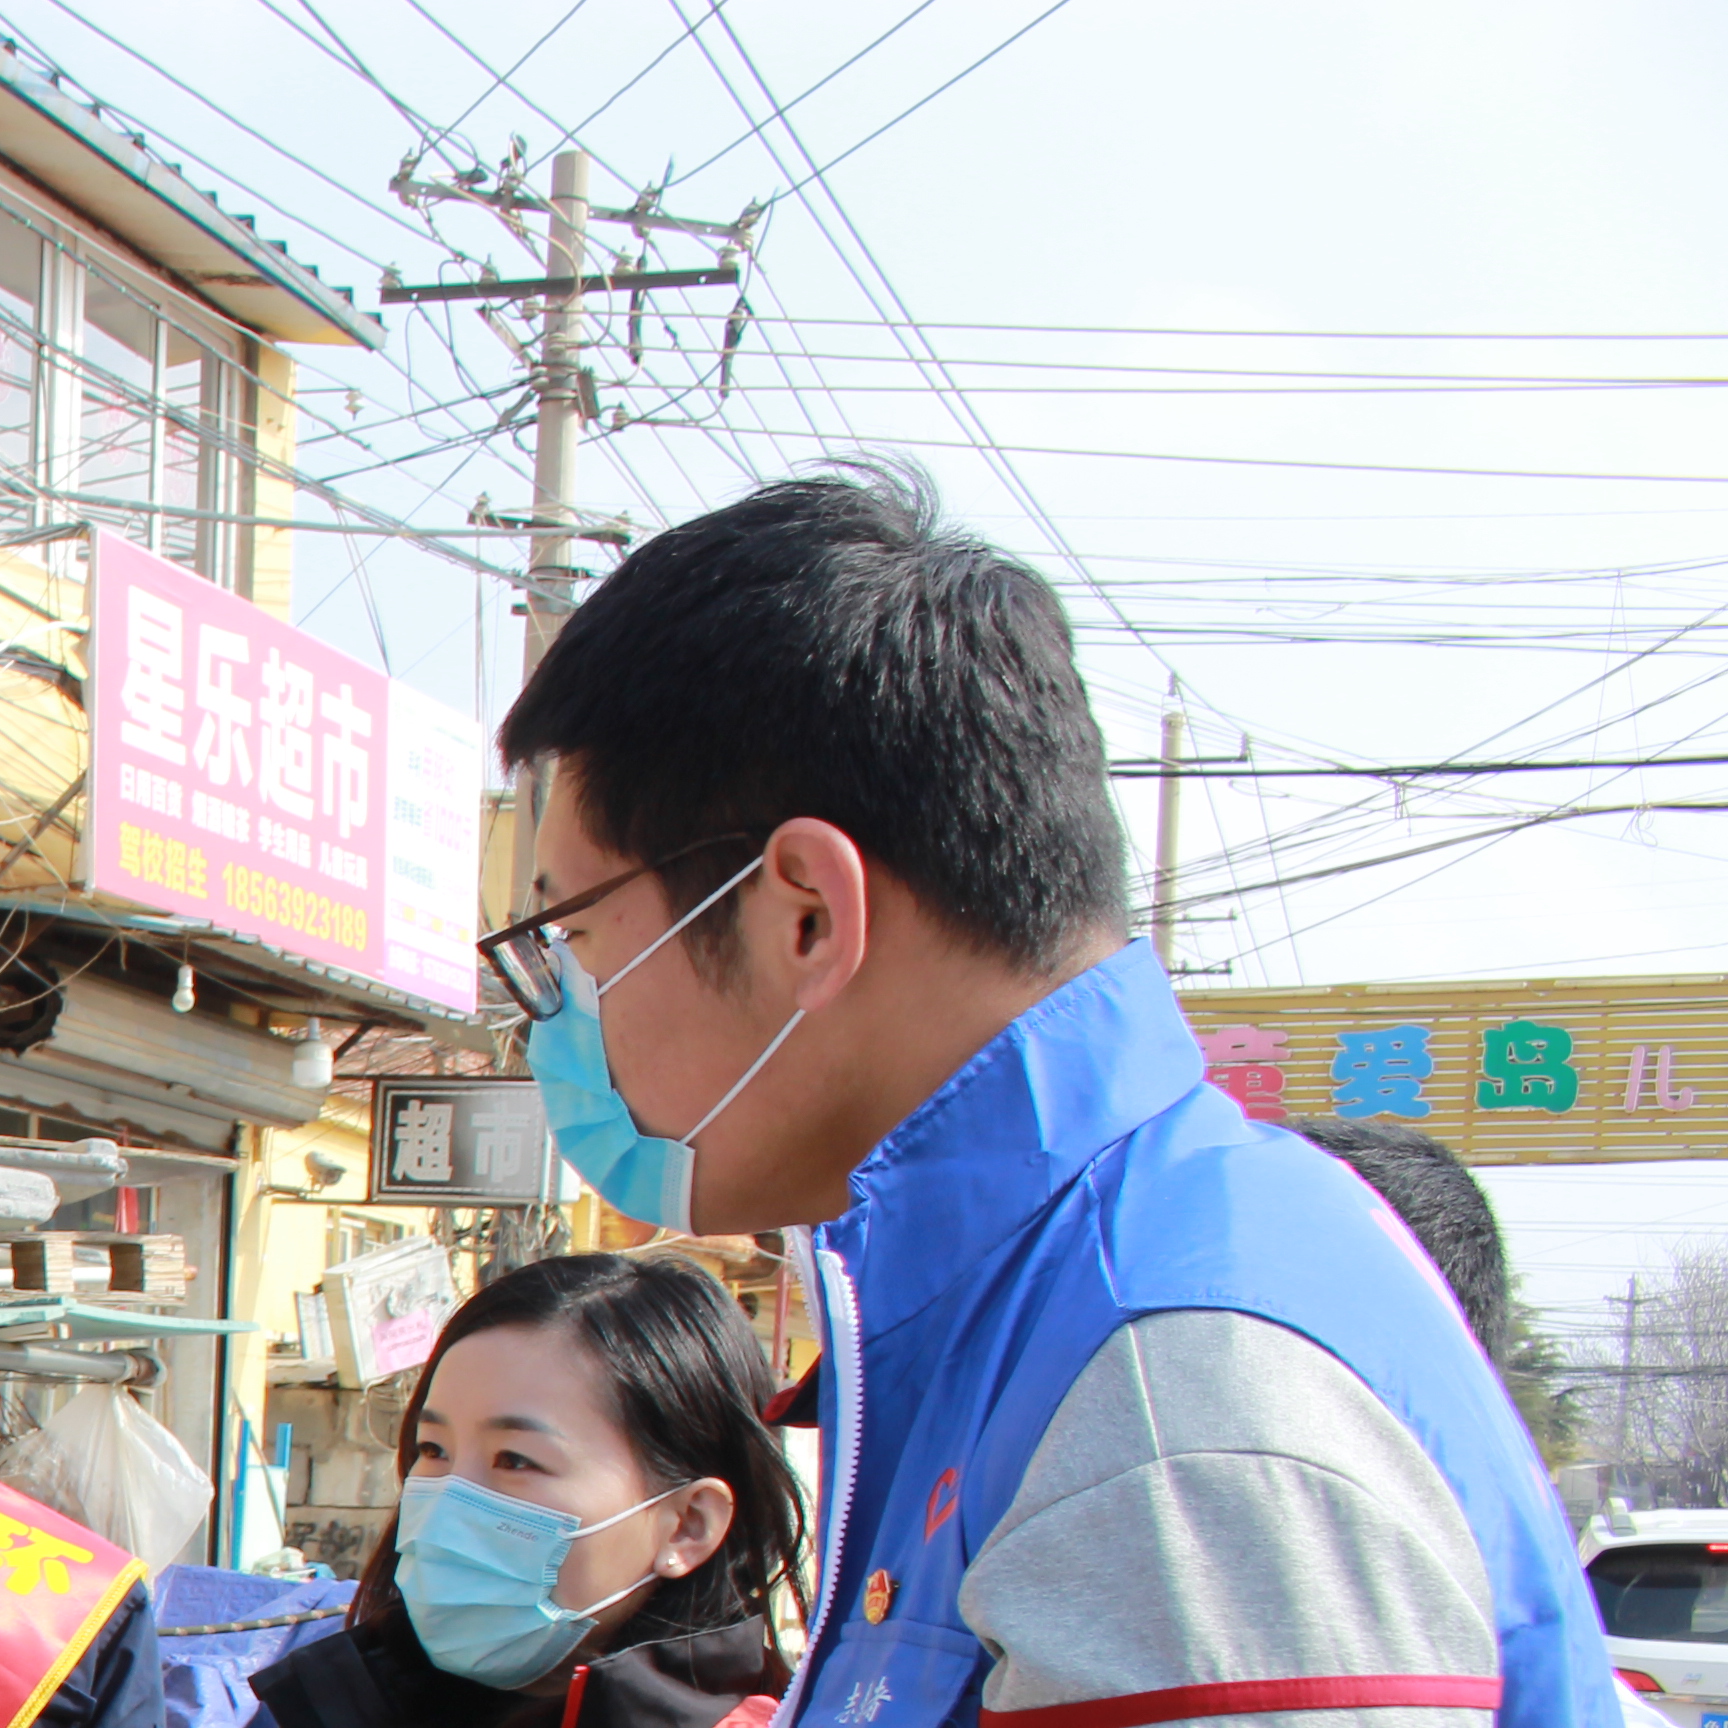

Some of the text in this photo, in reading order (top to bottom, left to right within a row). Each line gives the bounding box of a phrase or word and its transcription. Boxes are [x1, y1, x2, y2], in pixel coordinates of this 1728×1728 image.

[120, 584, 372, 839] 星乐超市
[118, 821, 209, 900] 驾校招生
[222, 862, 367, 951] 18563923189
[120, 762, 183, 820] 日用百货
[258, 816, 311, 870] 学生用品
[319, 842, 368, 890] 儿童玩具
[393, 1099, 531, 1183] 超市
